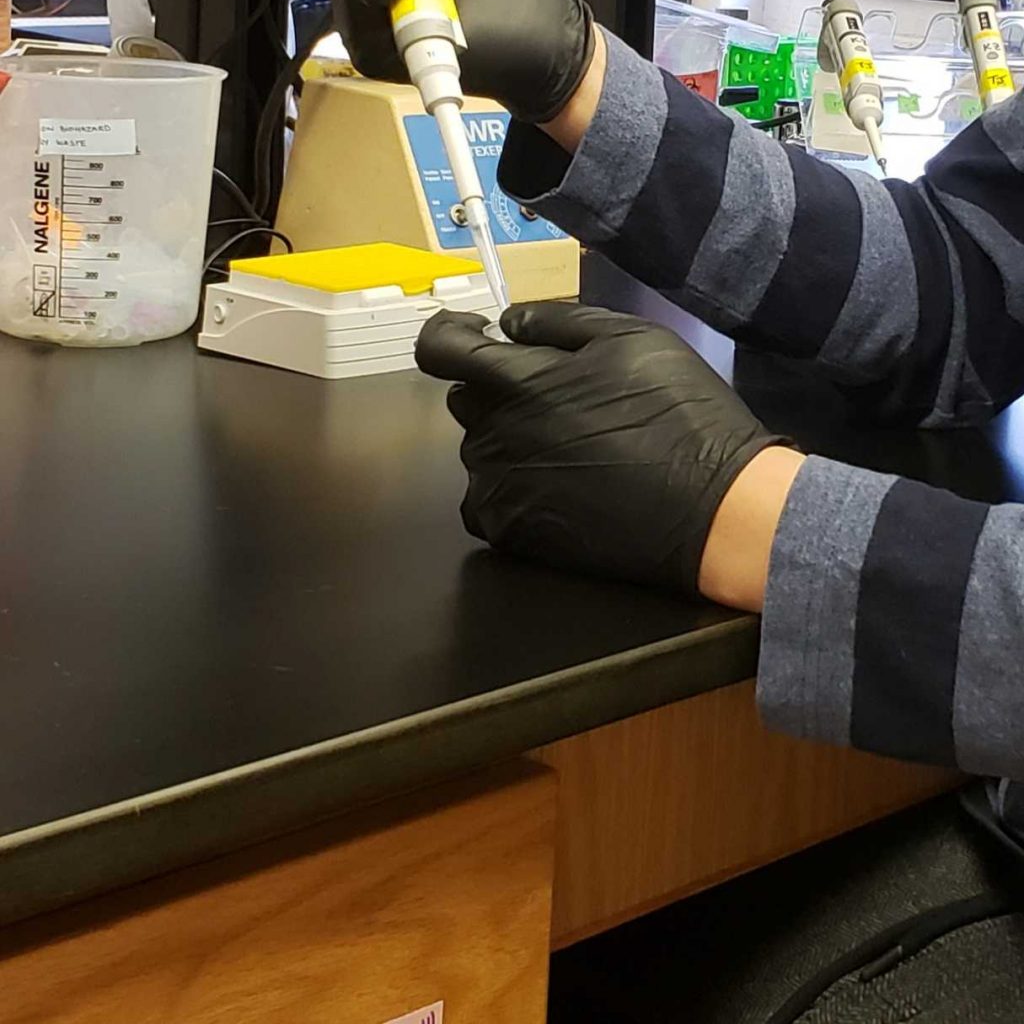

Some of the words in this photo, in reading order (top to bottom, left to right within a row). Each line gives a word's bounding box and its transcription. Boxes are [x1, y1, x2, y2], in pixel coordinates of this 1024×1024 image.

[59, 124, 112, 133] BIOHAZARD
[466, 119, 506, 143] WR
[56, 139, 87, 147] WASTE
[88, 196, 102, 204] 700
[34, 161, 50, 254] NALGENE
[104, 290, 117, 298] 200
